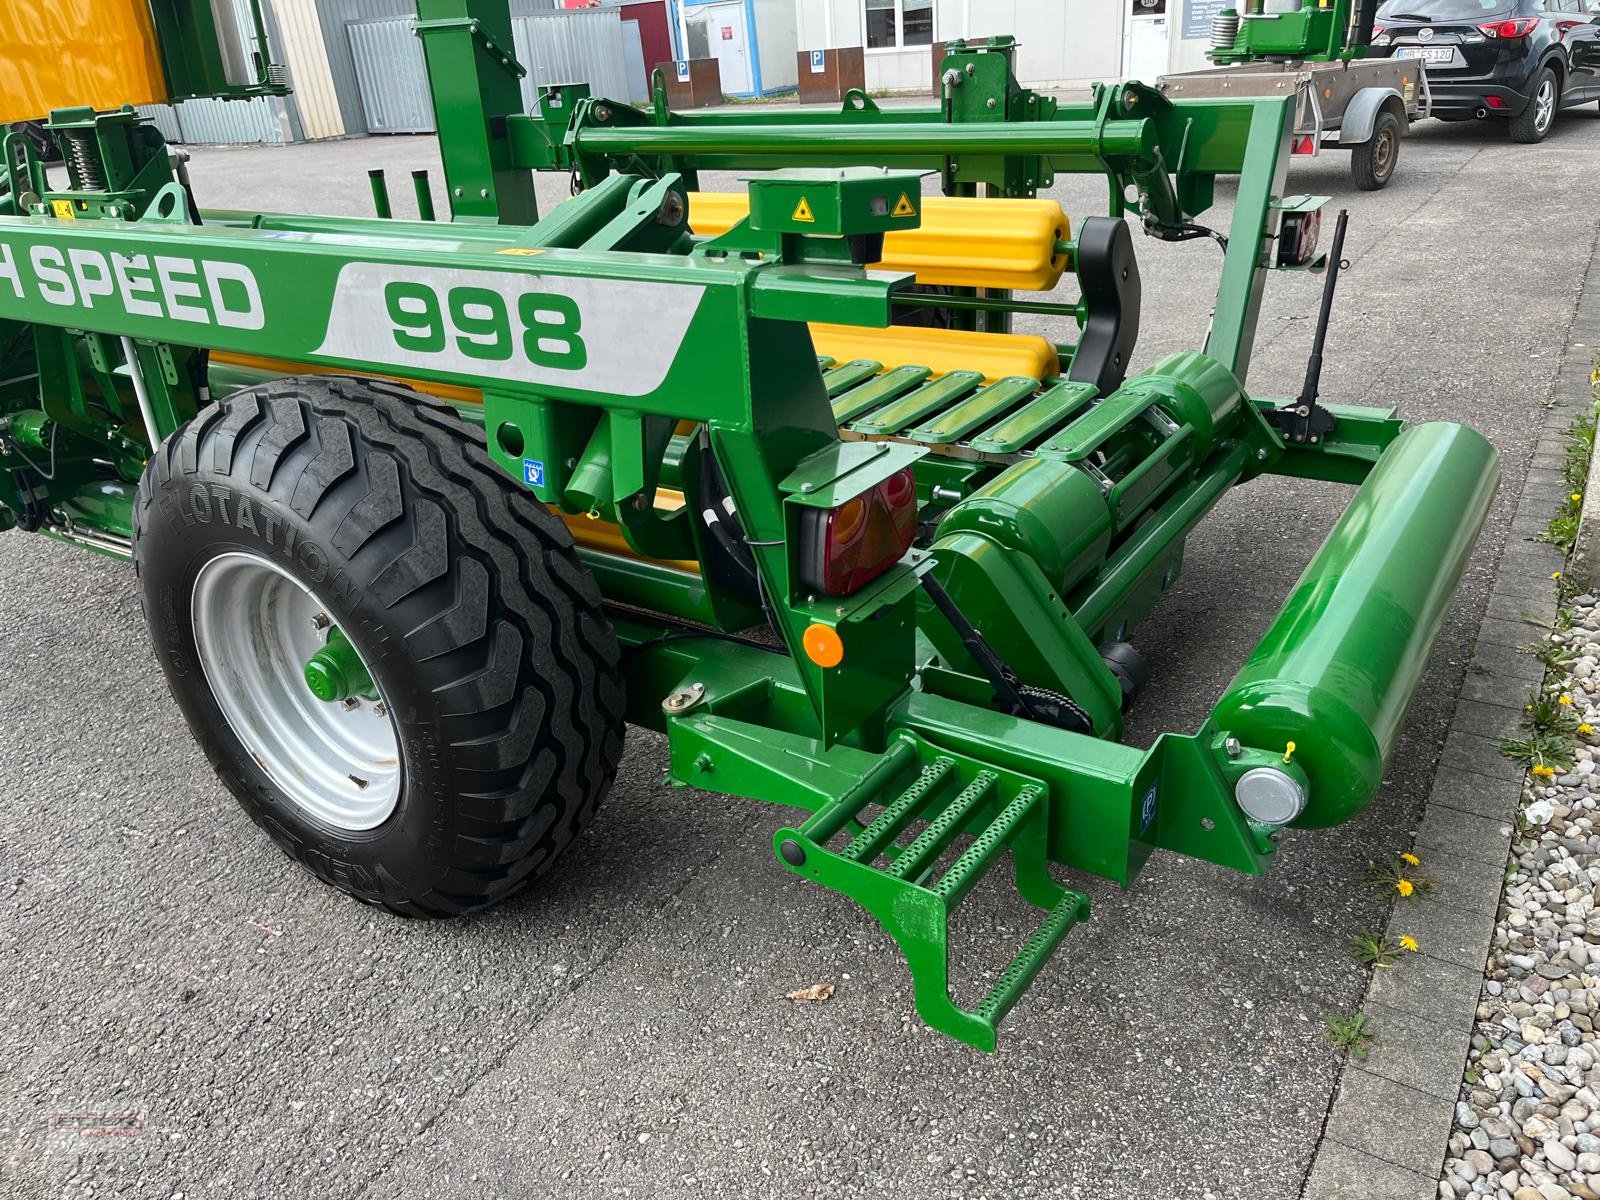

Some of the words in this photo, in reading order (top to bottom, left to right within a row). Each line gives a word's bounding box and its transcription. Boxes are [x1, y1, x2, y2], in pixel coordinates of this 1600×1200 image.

[679, 62, 686, 75] P
[813, 52, 821, 65] P
[30, 245, 265, 331] SPEED
[384, 281, 588, 371] 998
[158, 483, 365, 617] FLOTATION
